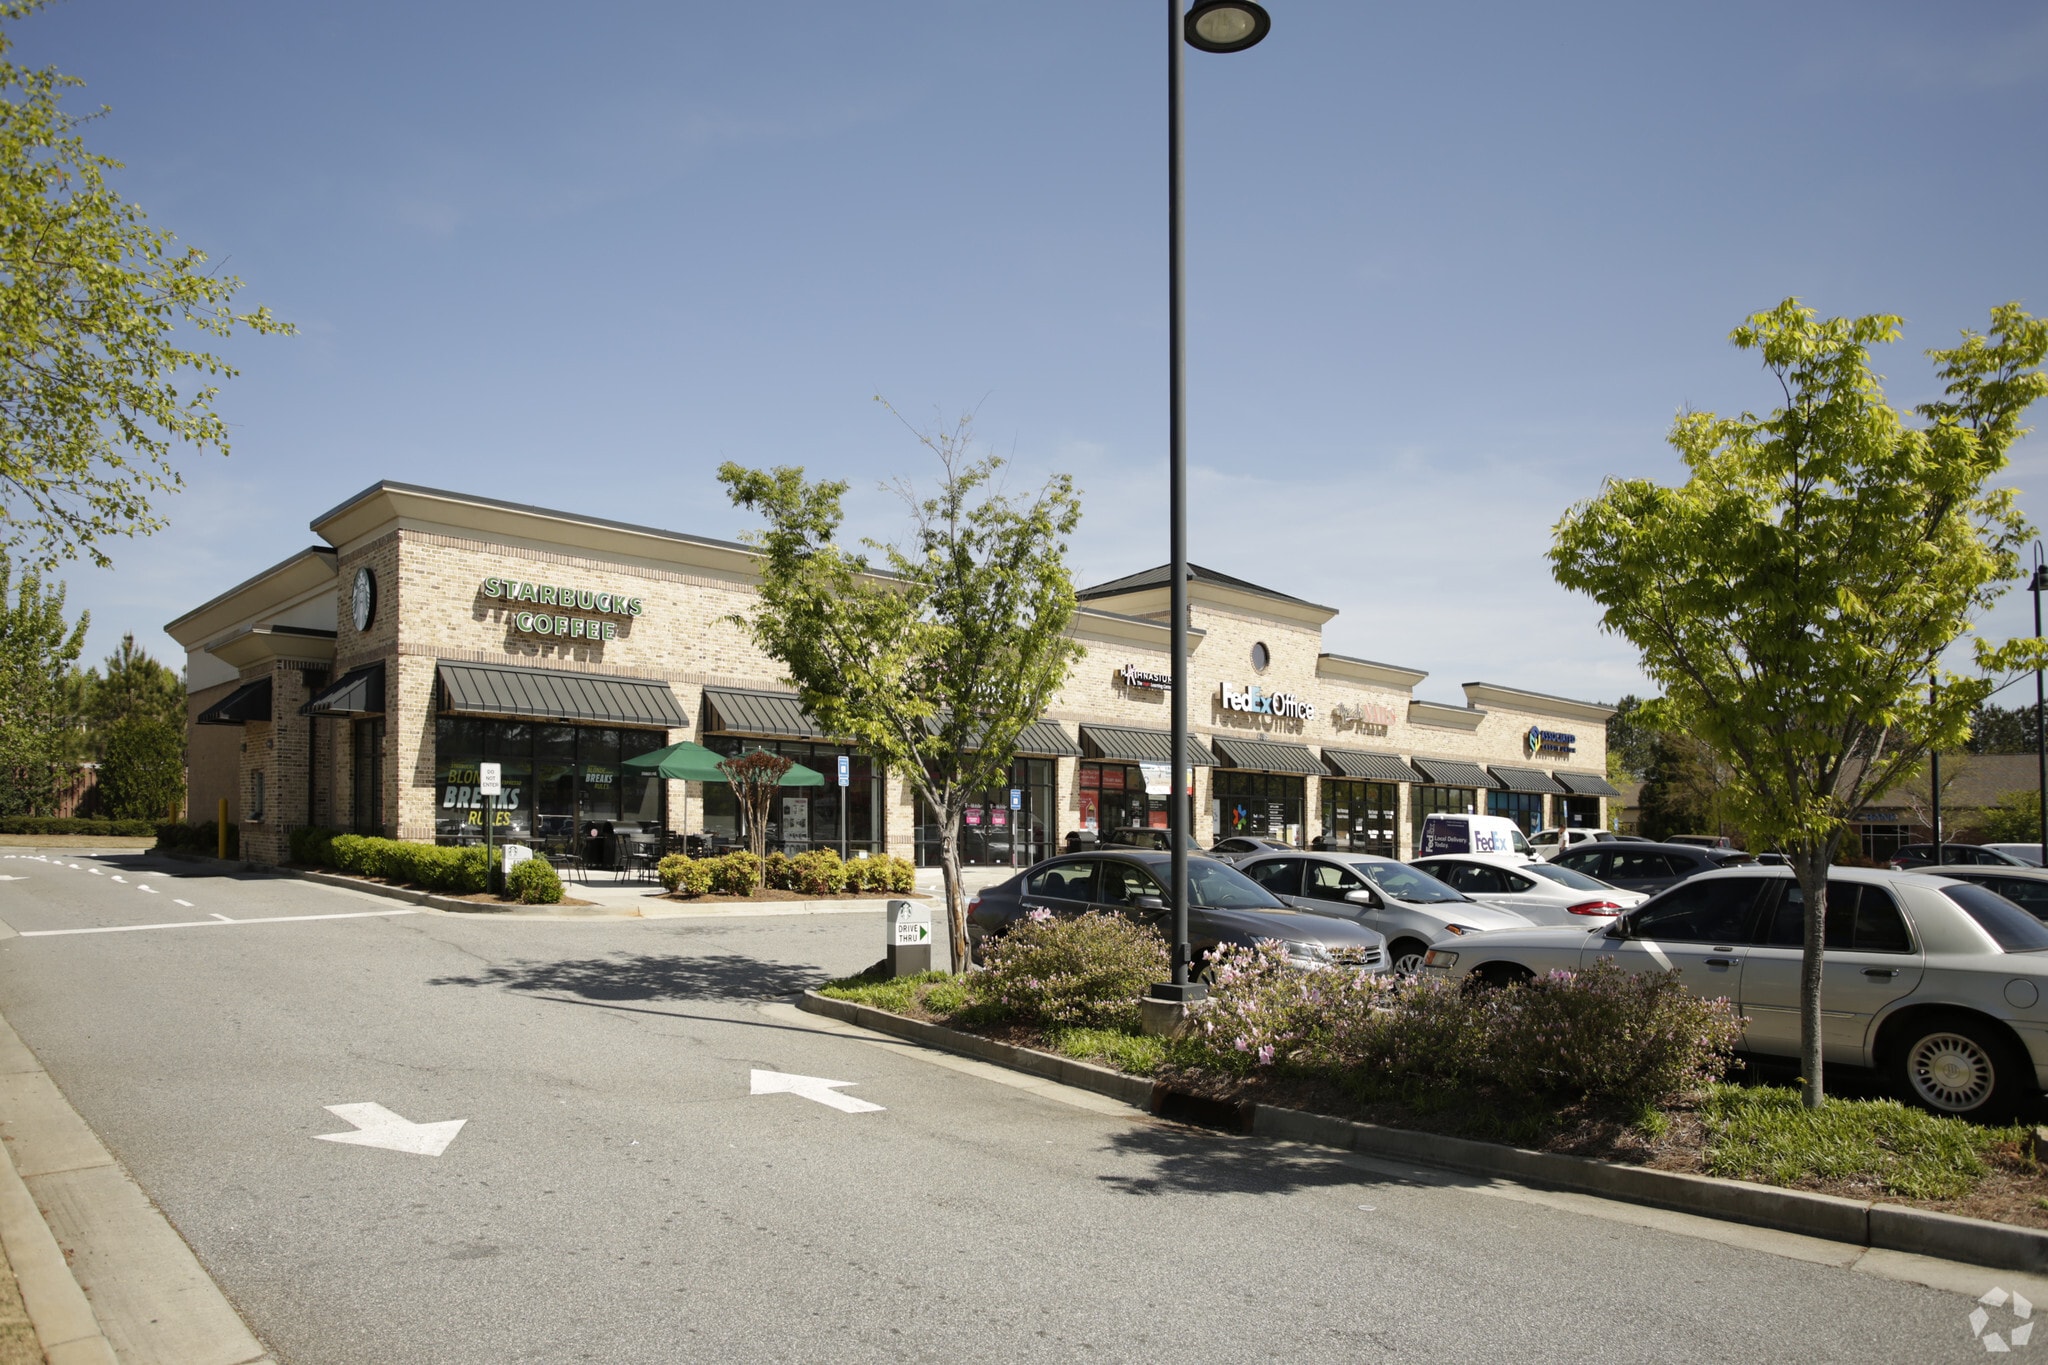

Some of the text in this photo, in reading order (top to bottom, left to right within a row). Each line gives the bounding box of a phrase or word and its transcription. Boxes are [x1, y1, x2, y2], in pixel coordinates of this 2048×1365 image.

[484, 576, 643, 616] STARBUCKS
[516, 611, 616, 641] COFFEE
[1221, 681, 1272, 715] FedEx
[1272, 691, 1315, 721] Office
[1540, 730, 1576, 744] ASSOCIATED
[448, 769, 481, 784] BLON
[585, 773, 613, 784] BREAKS
[468, 811, 511, 827] RUES
[1425, 823, 1436, 853] FedEx
[1474, 830, 1508, 851] FedEx
[898, 924, 918, 933] DRIVE
[899, 934, 918, 943] THRU
